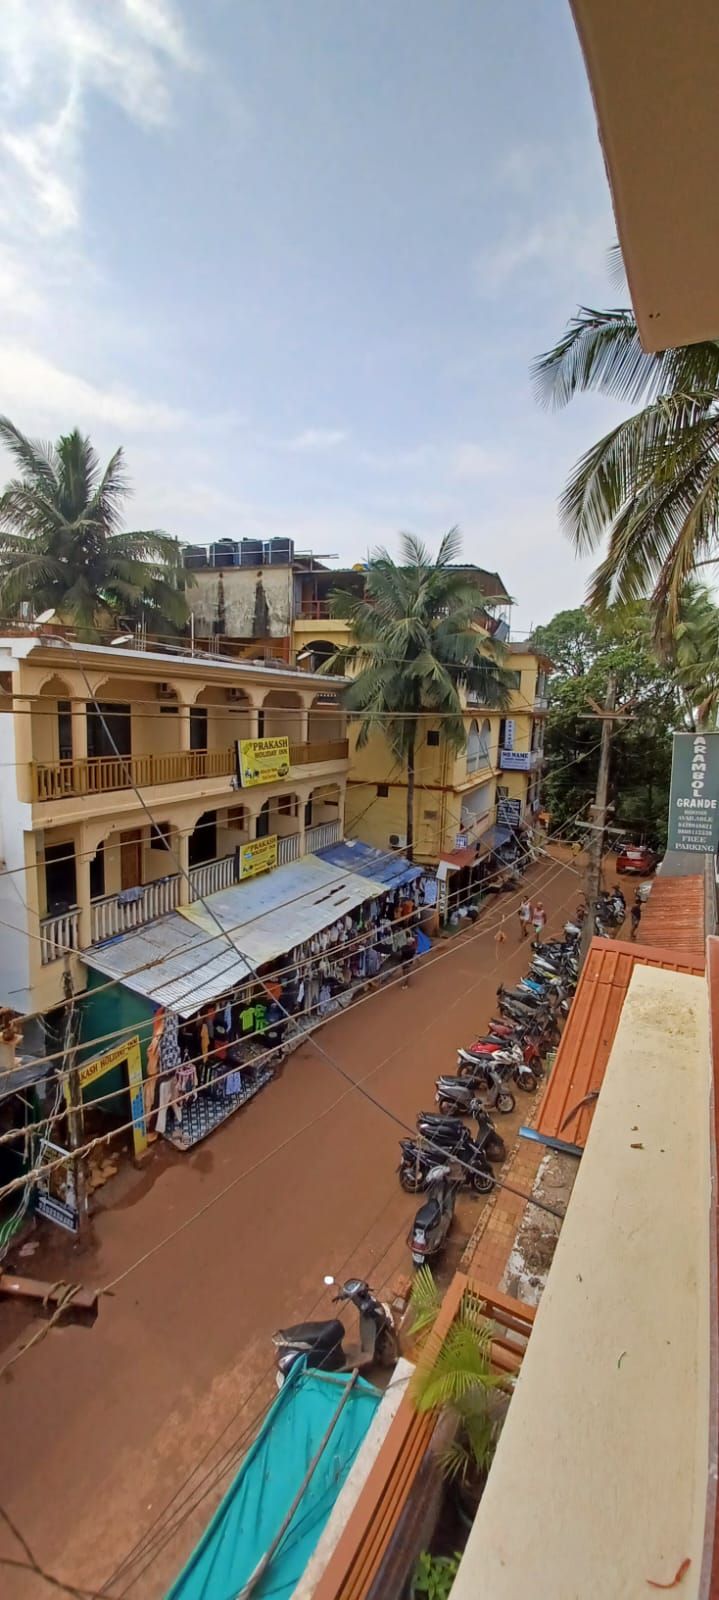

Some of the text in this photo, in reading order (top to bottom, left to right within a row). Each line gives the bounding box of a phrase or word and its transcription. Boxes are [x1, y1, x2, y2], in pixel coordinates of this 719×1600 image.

[253, 739, 288, 751] PRAKASH
[691, 736, 707, 797] ARAMBOL
[676, 798, 718, 809] GRANDE
[682, 835, 707, 843] FREE
[674, 842, 714, 852] PARKING
